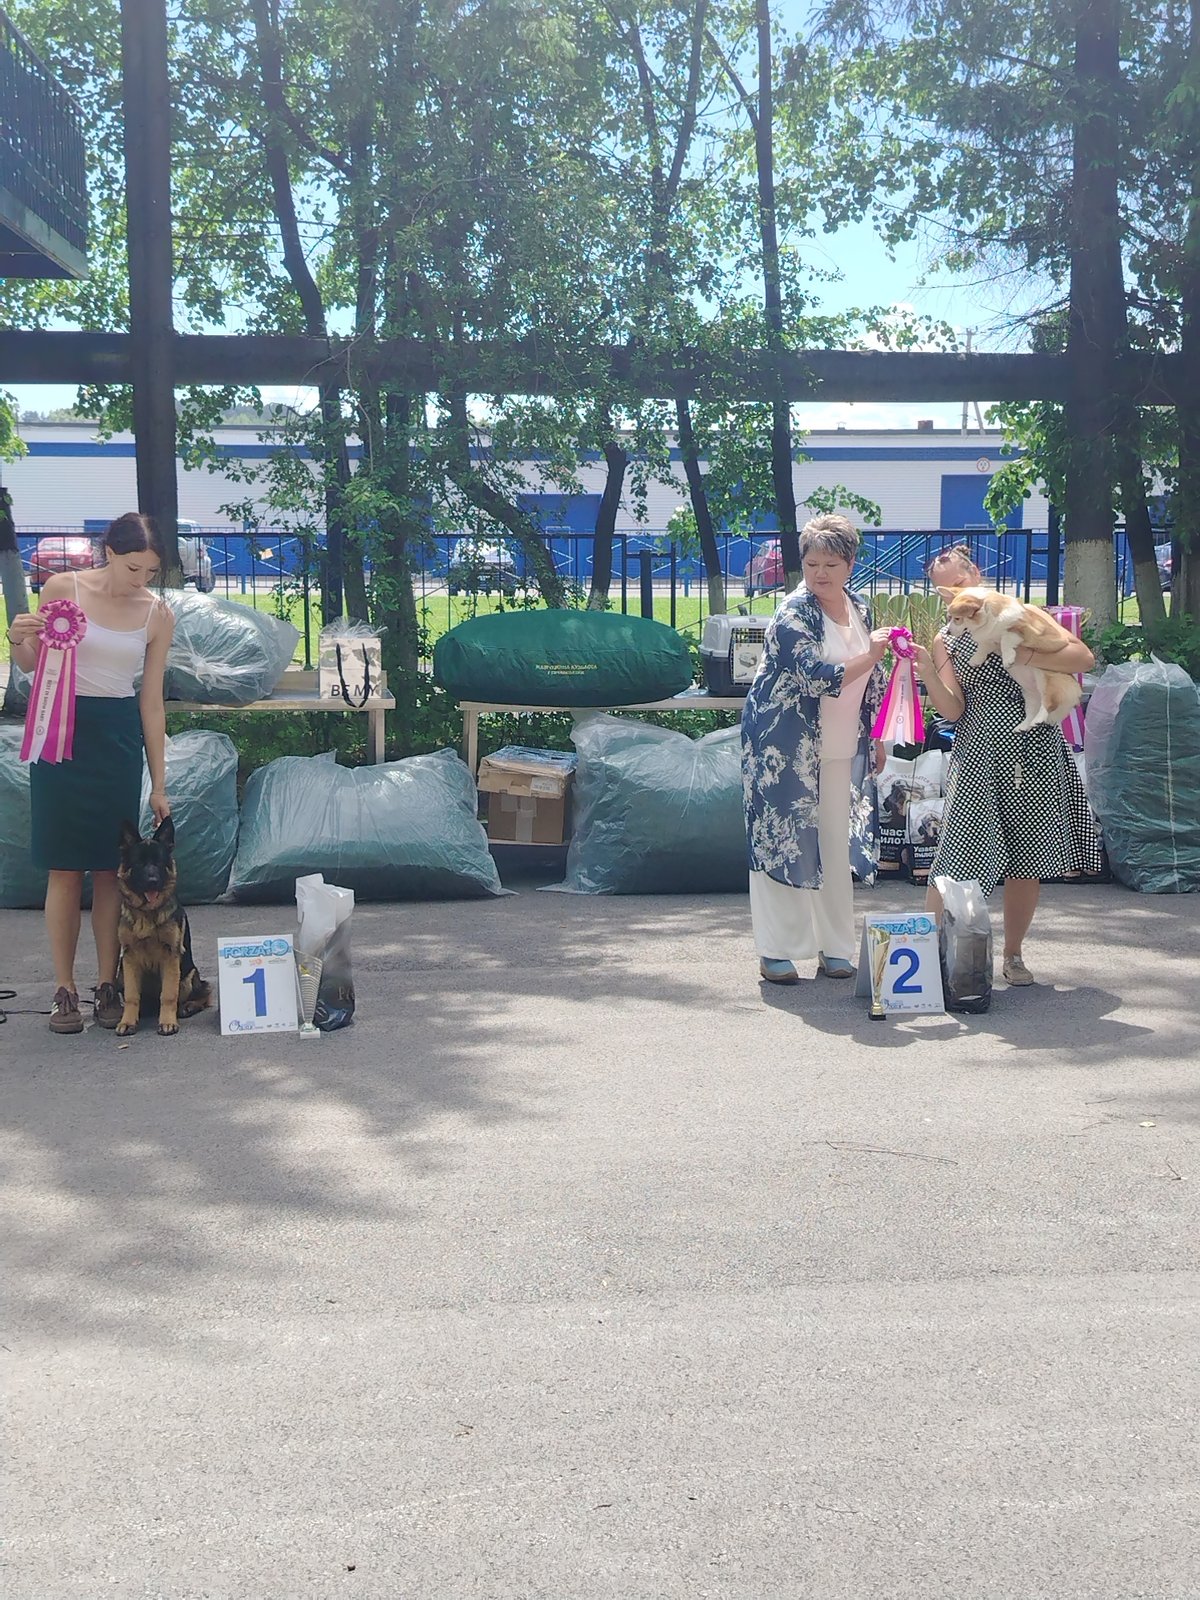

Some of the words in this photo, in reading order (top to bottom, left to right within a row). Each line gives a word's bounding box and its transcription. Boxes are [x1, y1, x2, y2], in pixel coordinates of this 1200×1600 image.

[331, 684, 350, 697] BE
[354, 684, 379, 697] MY
[879, 826, 906, 836] шаст
[880, 836, 907, 845] илот
[889, 947, 923, 995] 2
[242, 968, 267, 1018] 1
